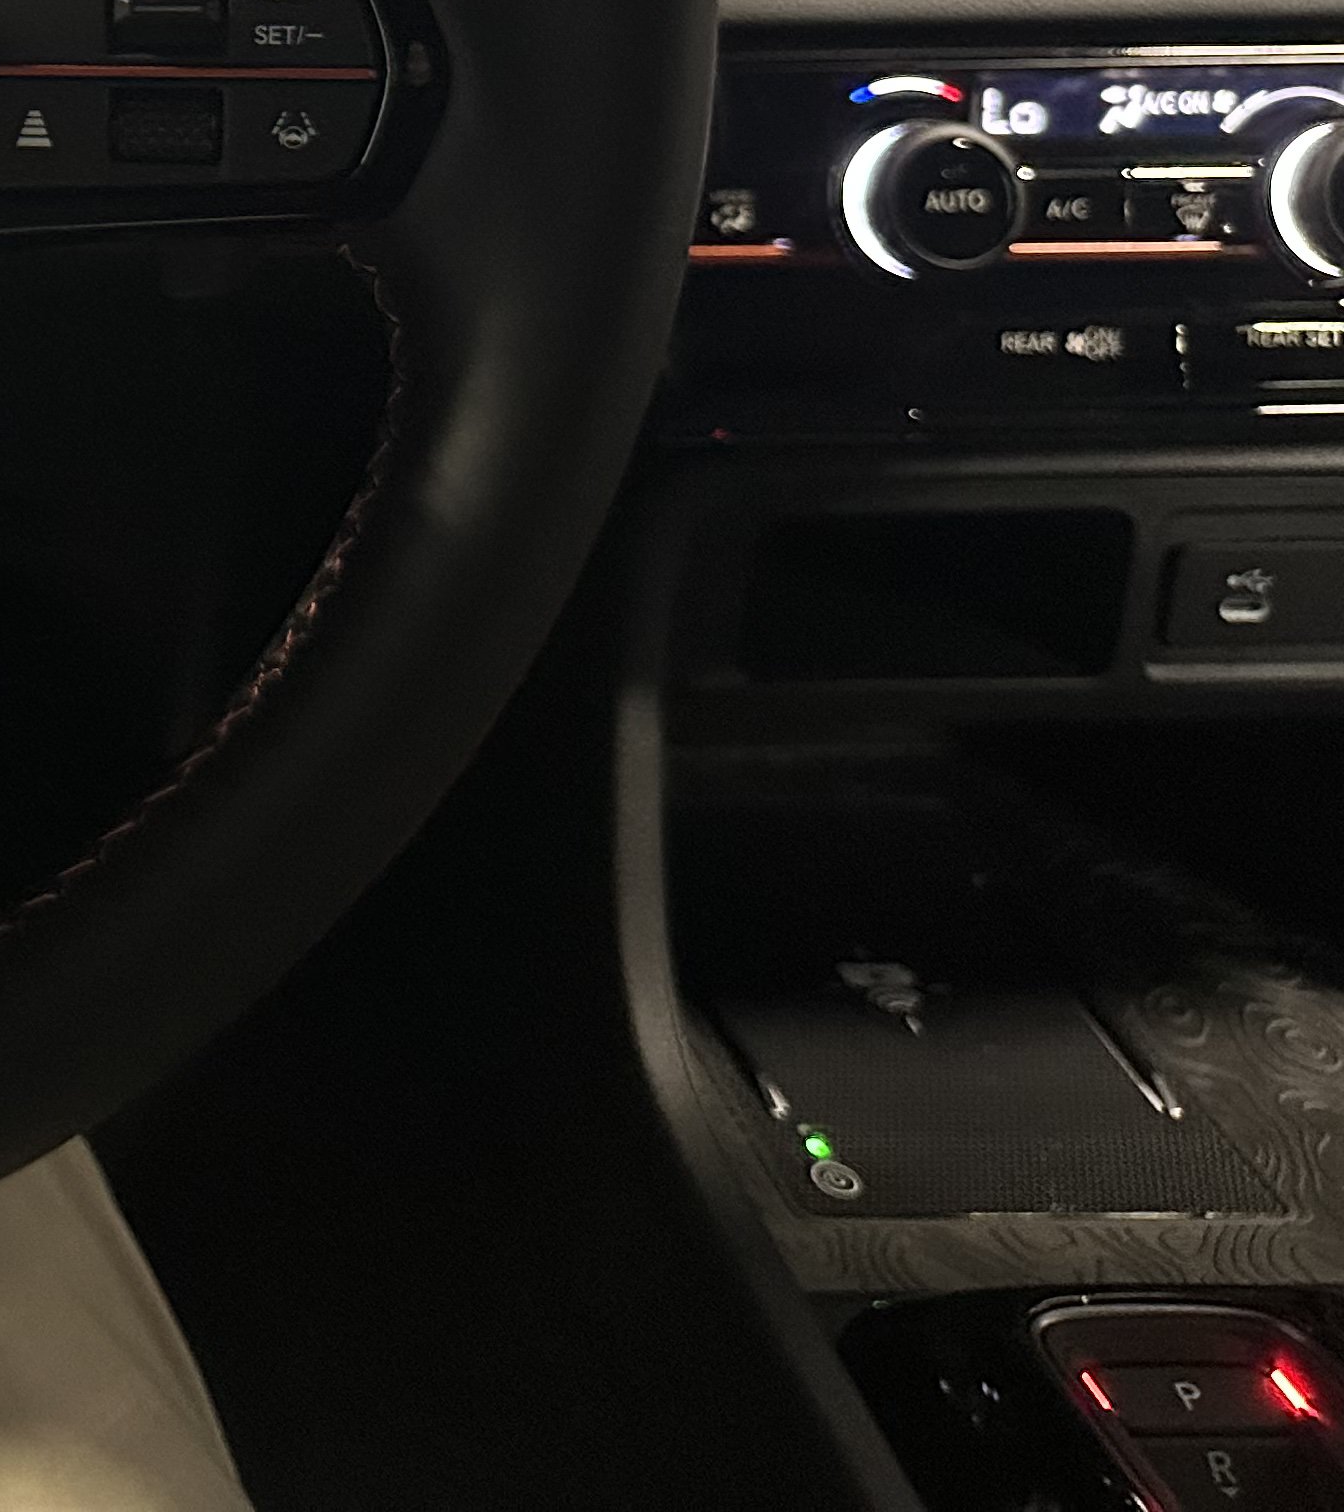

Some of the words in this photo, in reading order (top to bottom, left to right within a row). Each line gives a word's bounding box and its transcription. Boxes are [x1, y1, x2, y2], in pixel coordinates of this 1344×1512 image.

[925, 188, 990, 214] AUTO
[1046, 199, 1092, 221] A/C
[1001, 330, 1059, 354] REAR
[1173, 1381, 1202, 1412] P
